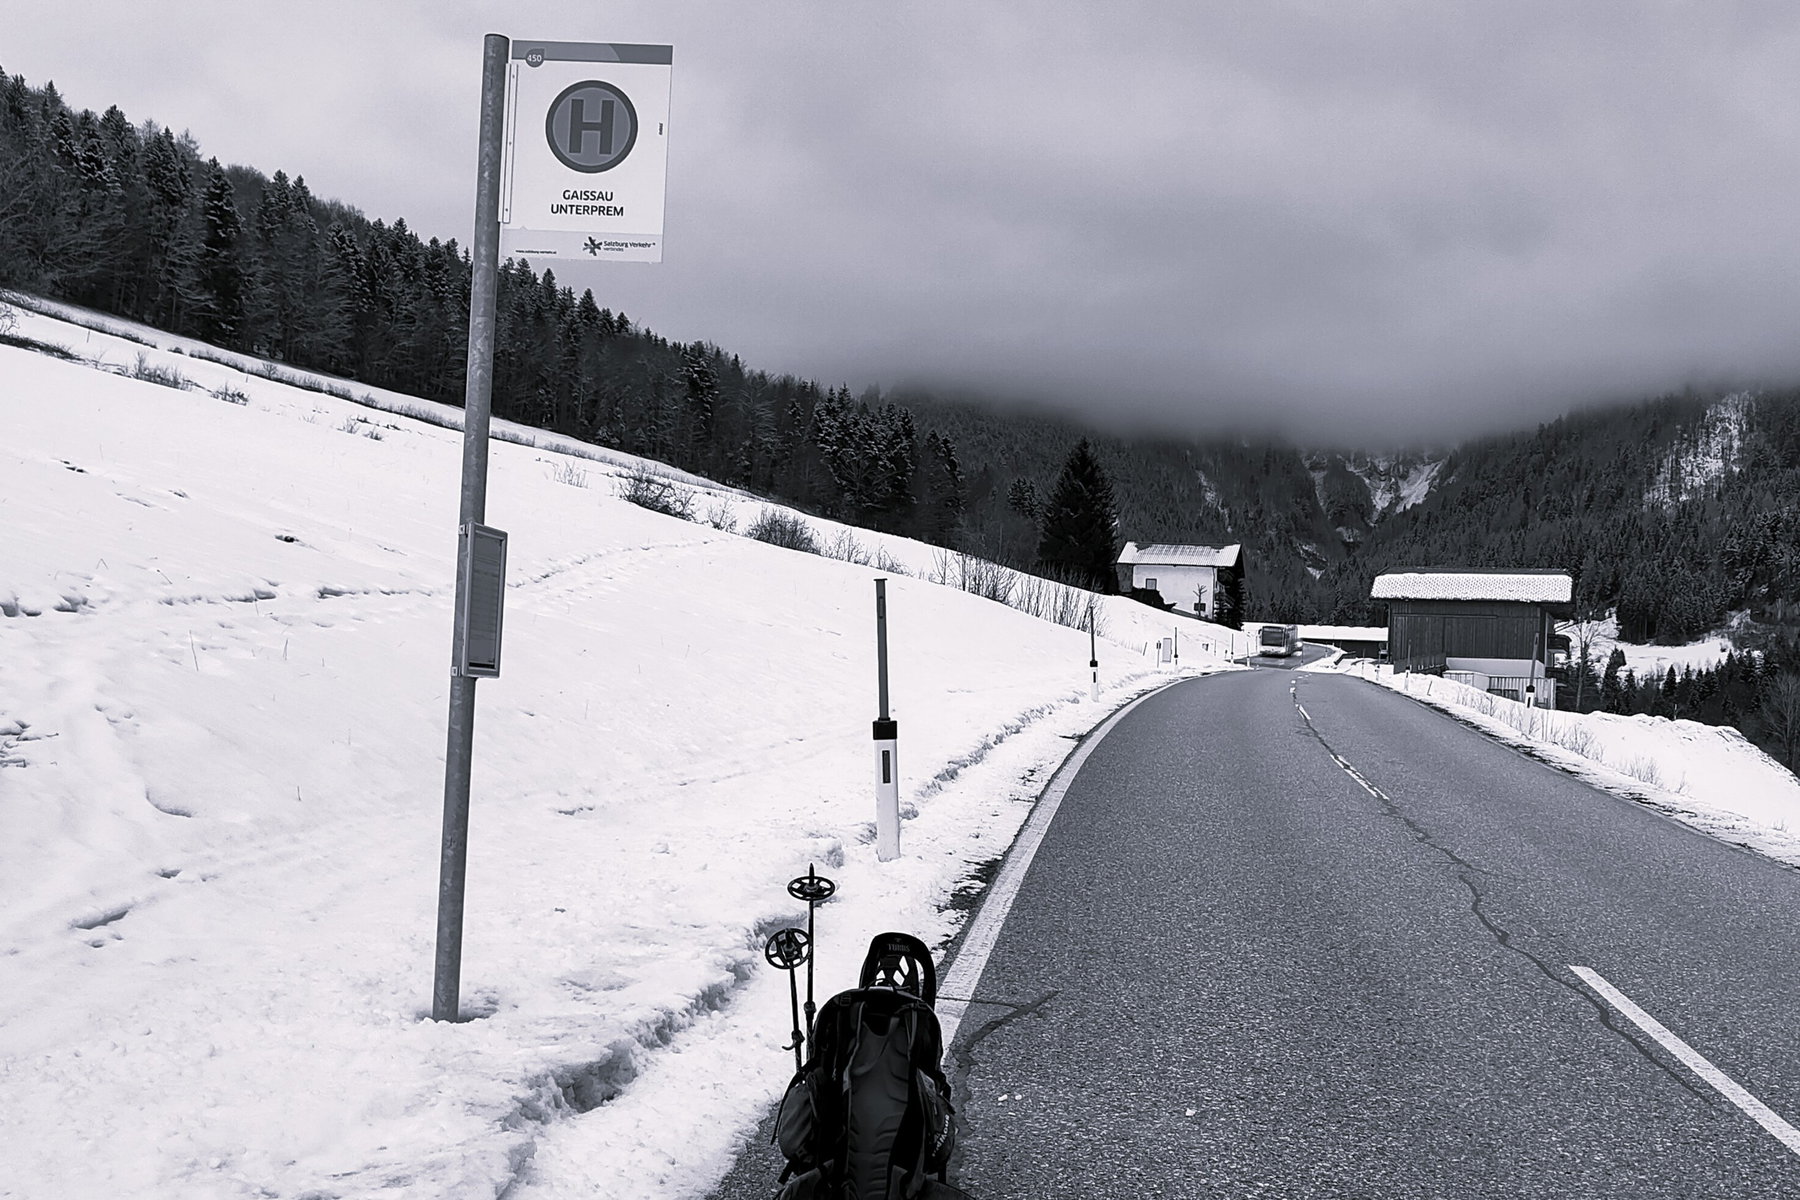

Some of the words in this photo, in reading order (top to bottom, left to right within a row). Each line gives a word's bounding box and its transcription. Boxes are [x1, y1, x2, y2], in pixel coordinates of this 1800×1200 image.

[527, 54, 542, 63] 450
[569, 98, 615, 155] H
[562, 189, 614, 202] GAISSAU
[550, 203, 624, 217] UNTERPREM
[603, 240, 629, 248] Salzburg
